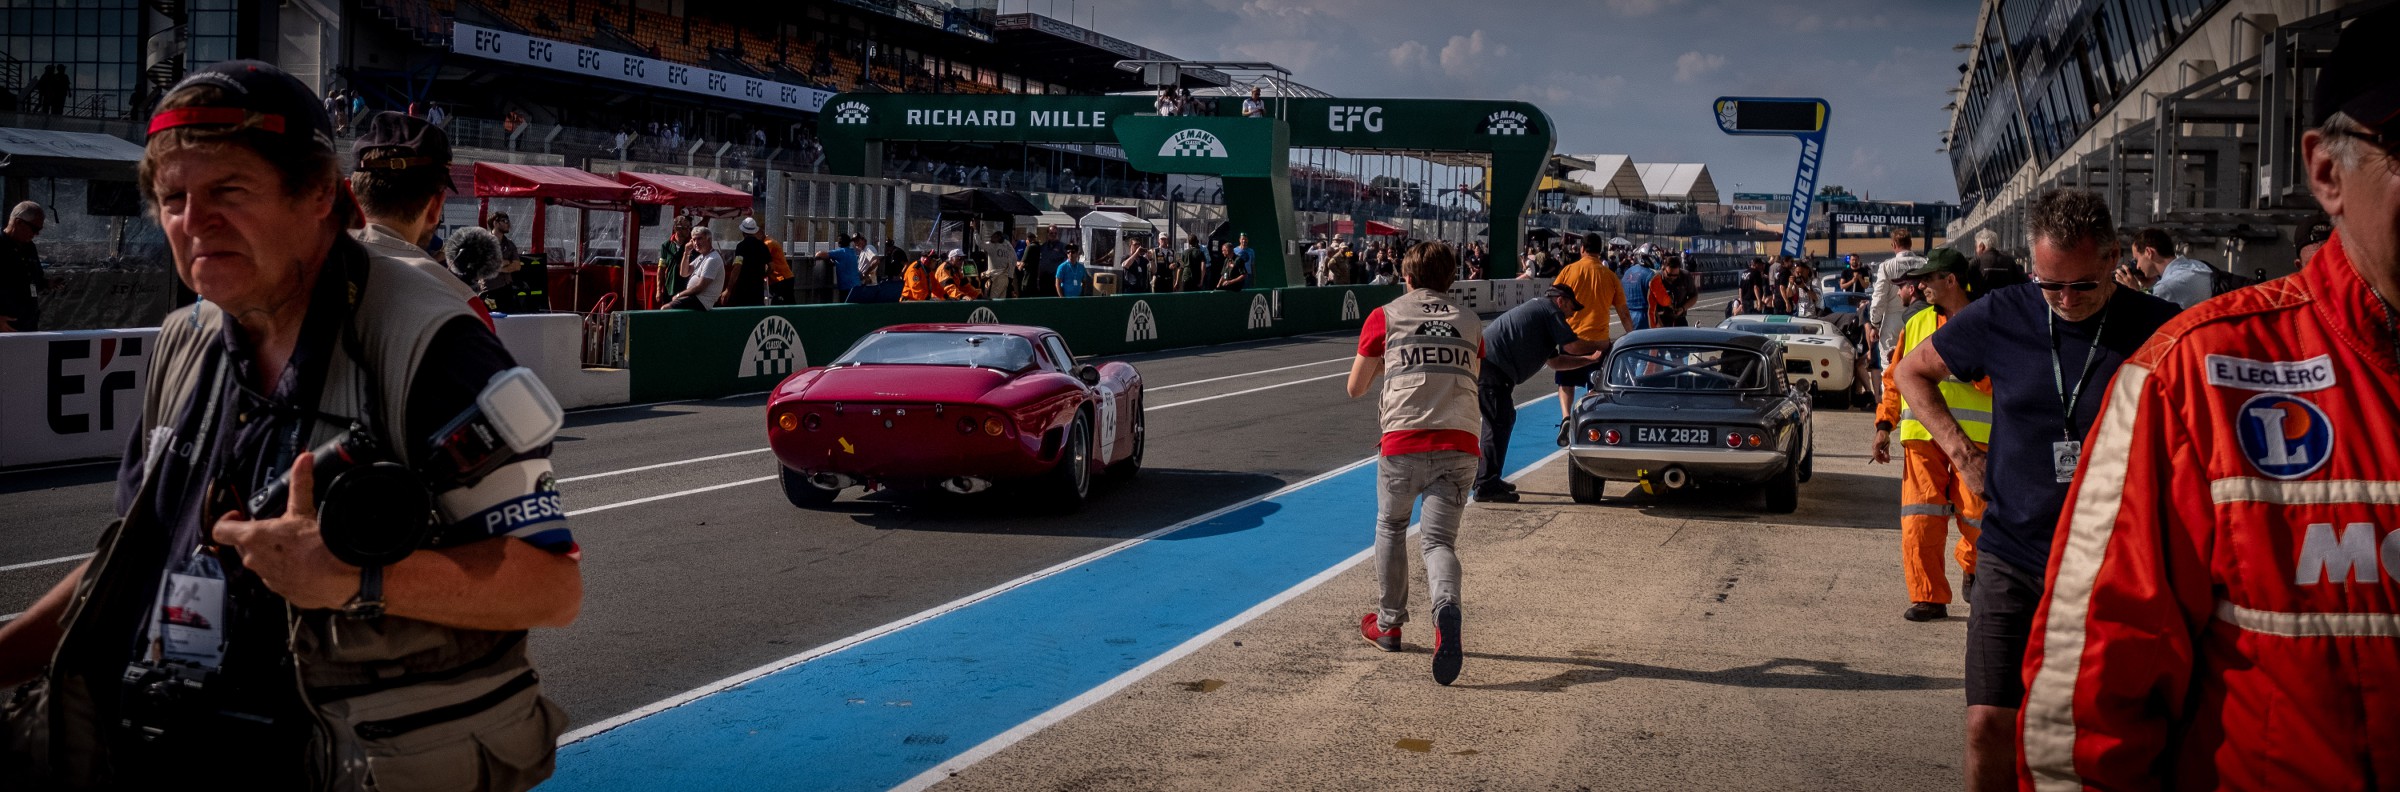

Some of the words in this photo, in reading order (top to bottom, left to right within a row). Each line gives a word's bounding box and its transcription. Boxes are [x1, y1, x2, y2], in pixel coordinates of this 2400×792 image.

[475, 30, 500, 53] EFG
[529, 40, 552, 62] EFG
[578, 49, 600, 70] EFG
[624, 57, 645, 78] EFG
[668, 65, 688, 86] EFG
[708, 73, 727, 92] EFG
[745, 80, 763, 98] EFG
[781, 86, 797, 104] EFG
[907, 109, 1016, 126] RICHARD
[1030, 110, 1106, 128] MILLE
[1328, 105, 1384, 132] EFG
[1784, 138, 1820, 257] MICHELIN
[1836, 213, 1887, 224] RICHARD
[1890, 215, 1925, 225] MILLE
[1421, 303, 1450, 313] 374
[1400, 346, 1472, 369] MEDIA
[2216, 362, 2234, 381] E.
[2237, 364, 2327, 387] LECLERC
[47, 337, 150, 435] EF
[1105, 411, 1115, 438] 14
[1638, 427, 1667, 442] EAX
[1671, 428, 1710, 444] 282B
[485, 495, 562, 535] PRESS
